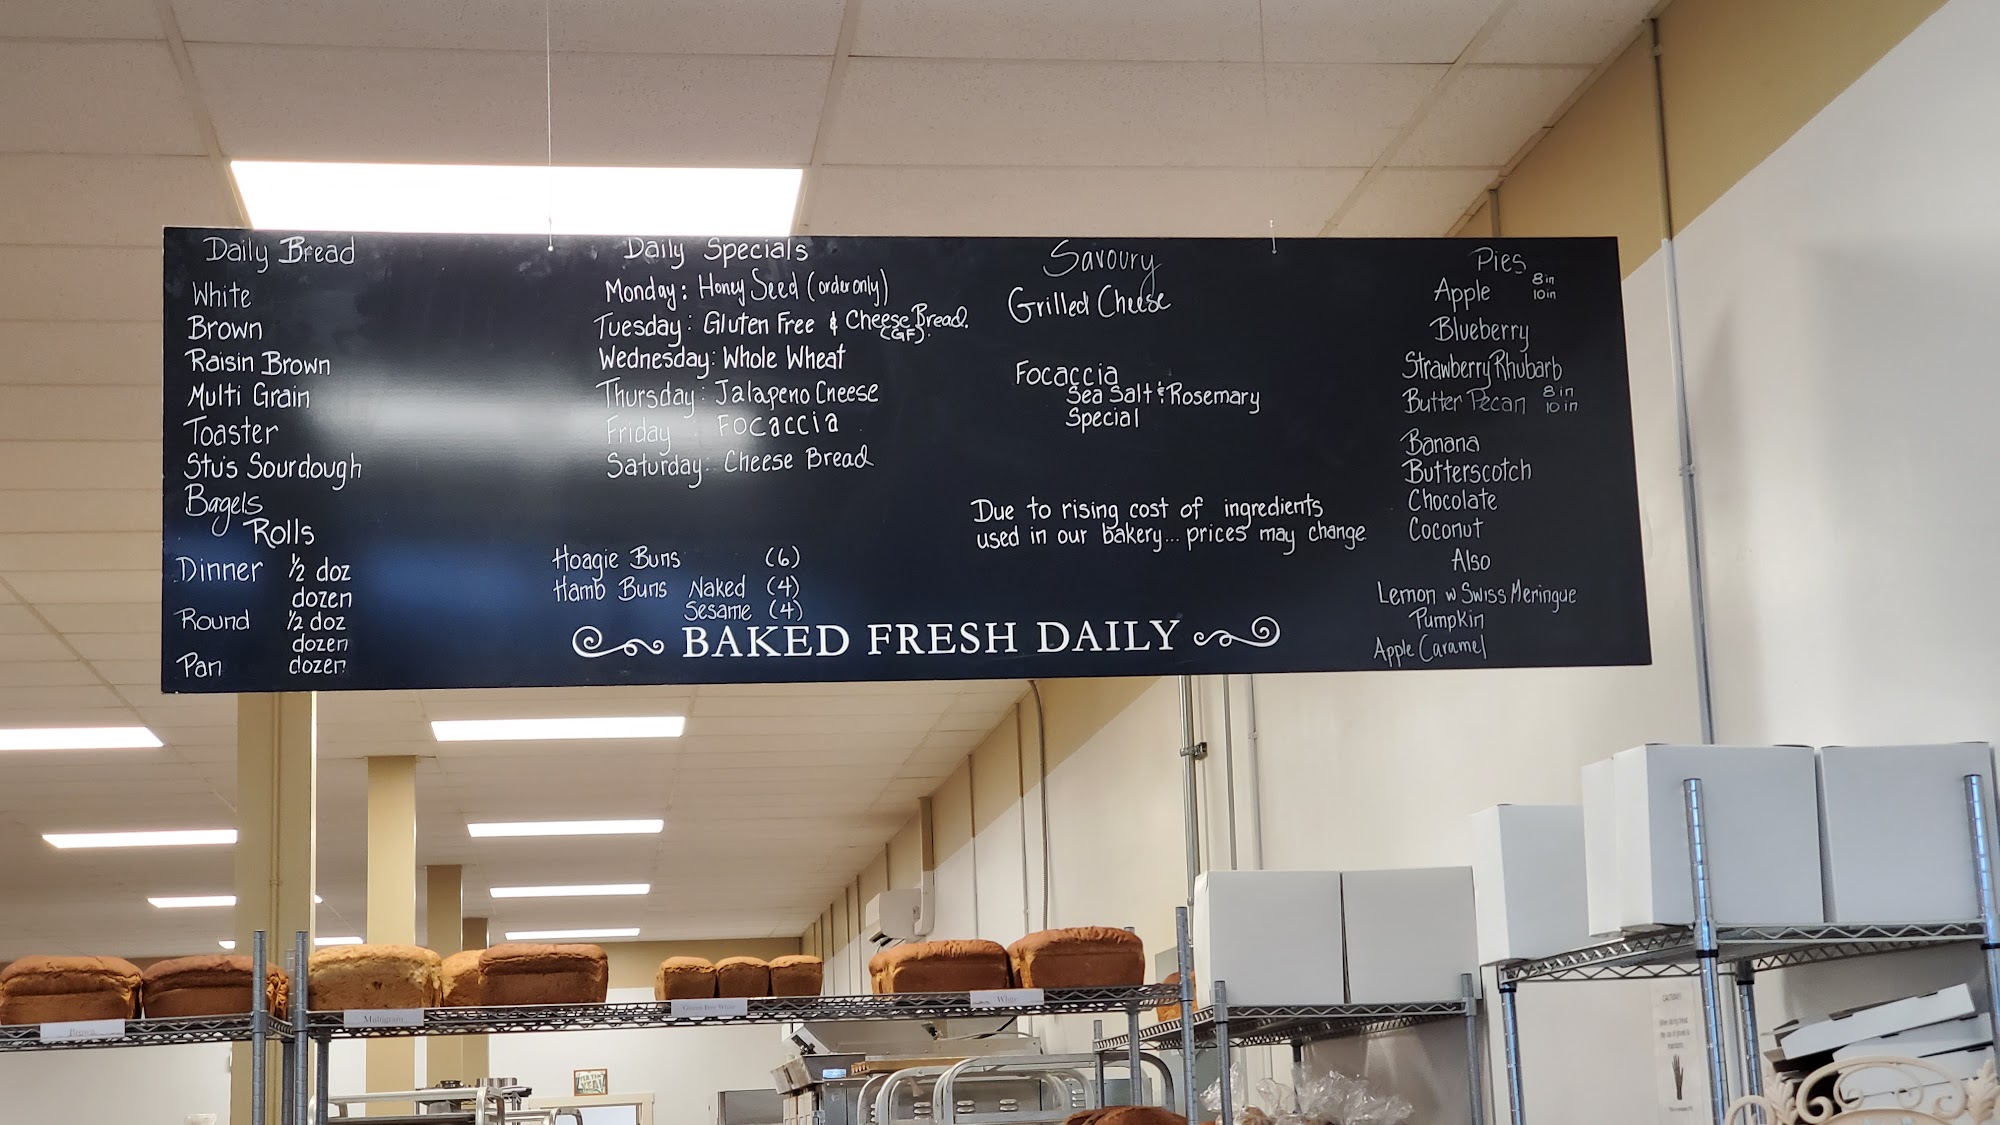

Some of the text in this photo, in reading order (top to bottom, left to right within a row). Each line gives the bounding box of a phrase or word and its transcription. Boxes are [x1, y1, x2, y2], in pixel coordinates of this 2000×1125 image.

[203, 236, 355, 273] Daily Bread
[624, 237, 809, 270] Daily Specials
[1043, 239, 1162, 298] Savoury
[1468, 246, 1527, 275] Pies
[192, 281, 251, 308] White
[605, 267, 889, 312] Monday: Honey Seed (order only)
[1008, 284, 1172, 324] Grilled Cheese
[1434, 277, 1491, 313] Apple
[187, 315, 262, 340] Brown
[703, 310, 769, 337] Gluten
[777, 313, 815, 336] Free
[845, 309, 911, 330] Cheese
[1429, 315, 1530, 353] Blueberry
[184, 348, 331, 376] Raisin Brown
[599, 343, 846, 380] Wednesday: Whole Wheat
[1015, 359, 1119, 388] Focaccia
[1401, 349, 1563, 390] Strawberry Rhubarb
[187, 382, 310, 410] Multi Grain
[714, 378, 810, 411] Jalapeno
[1065, 385, 1103, 405] Sea
[1108, 382, 1153, 404] Salt
[1166, 382, 1260, 415] Rosemary
[1401, 387, 1526, 414] Butter Pecan
[183, 415, 279, 447] Toaster
[1065, 407, 1139, 434] Special
[1400, 427, 1480, 457] Banana
[247, 452, 362, 491] Sourdough
[723, 450, 794, 474] Cheese
[806, 444, 874, 470] Bread
[1401, 457, 1533, 485] Butterscotch
[184, 483, 264, 538] Bagels
[970, 493, 1324, 529] Due to rising cost of ingredients
[1408, 487, 1499, 512] Chocolate
[243, 517, 315, 549] Rolls
[976, 525, 1020, 549] used
[1030, 526, 1047, 545] in
[1057, 527, 1087, 544] our
[1186, 522, 1247, 551] prices
[1259, 527, 1296, 556] may
[1408, 516, 1484, 542] Coconut
[176, 556, 264, 583] Dinner
[316, 556, 352, 582] doz
[552, 543, 800, 581] Hoagie Buns (6)
[1451, 548, 1491, 573] Also
[292, 587, 352, 609] dozen
[553, 574, 800, 602] Hamb Buns Naked (4)
[1377, 579, 1577, 614] Lemon w Swiss Meringue
[174, 607, 250, 631] Round
[310, 614, 346, 632] doz
[683, 600, 804, 622] Sesame (4)
[1408, 606, 1485, 633] Pumpkin
[292, 635, 349, 653] dozen
[681, 618, 1181, 658] BAKED FRESH DAILY
[1373, 633, 1487, 668] Apple Caramel
[176, 652, 346, 678] Pan dozen
